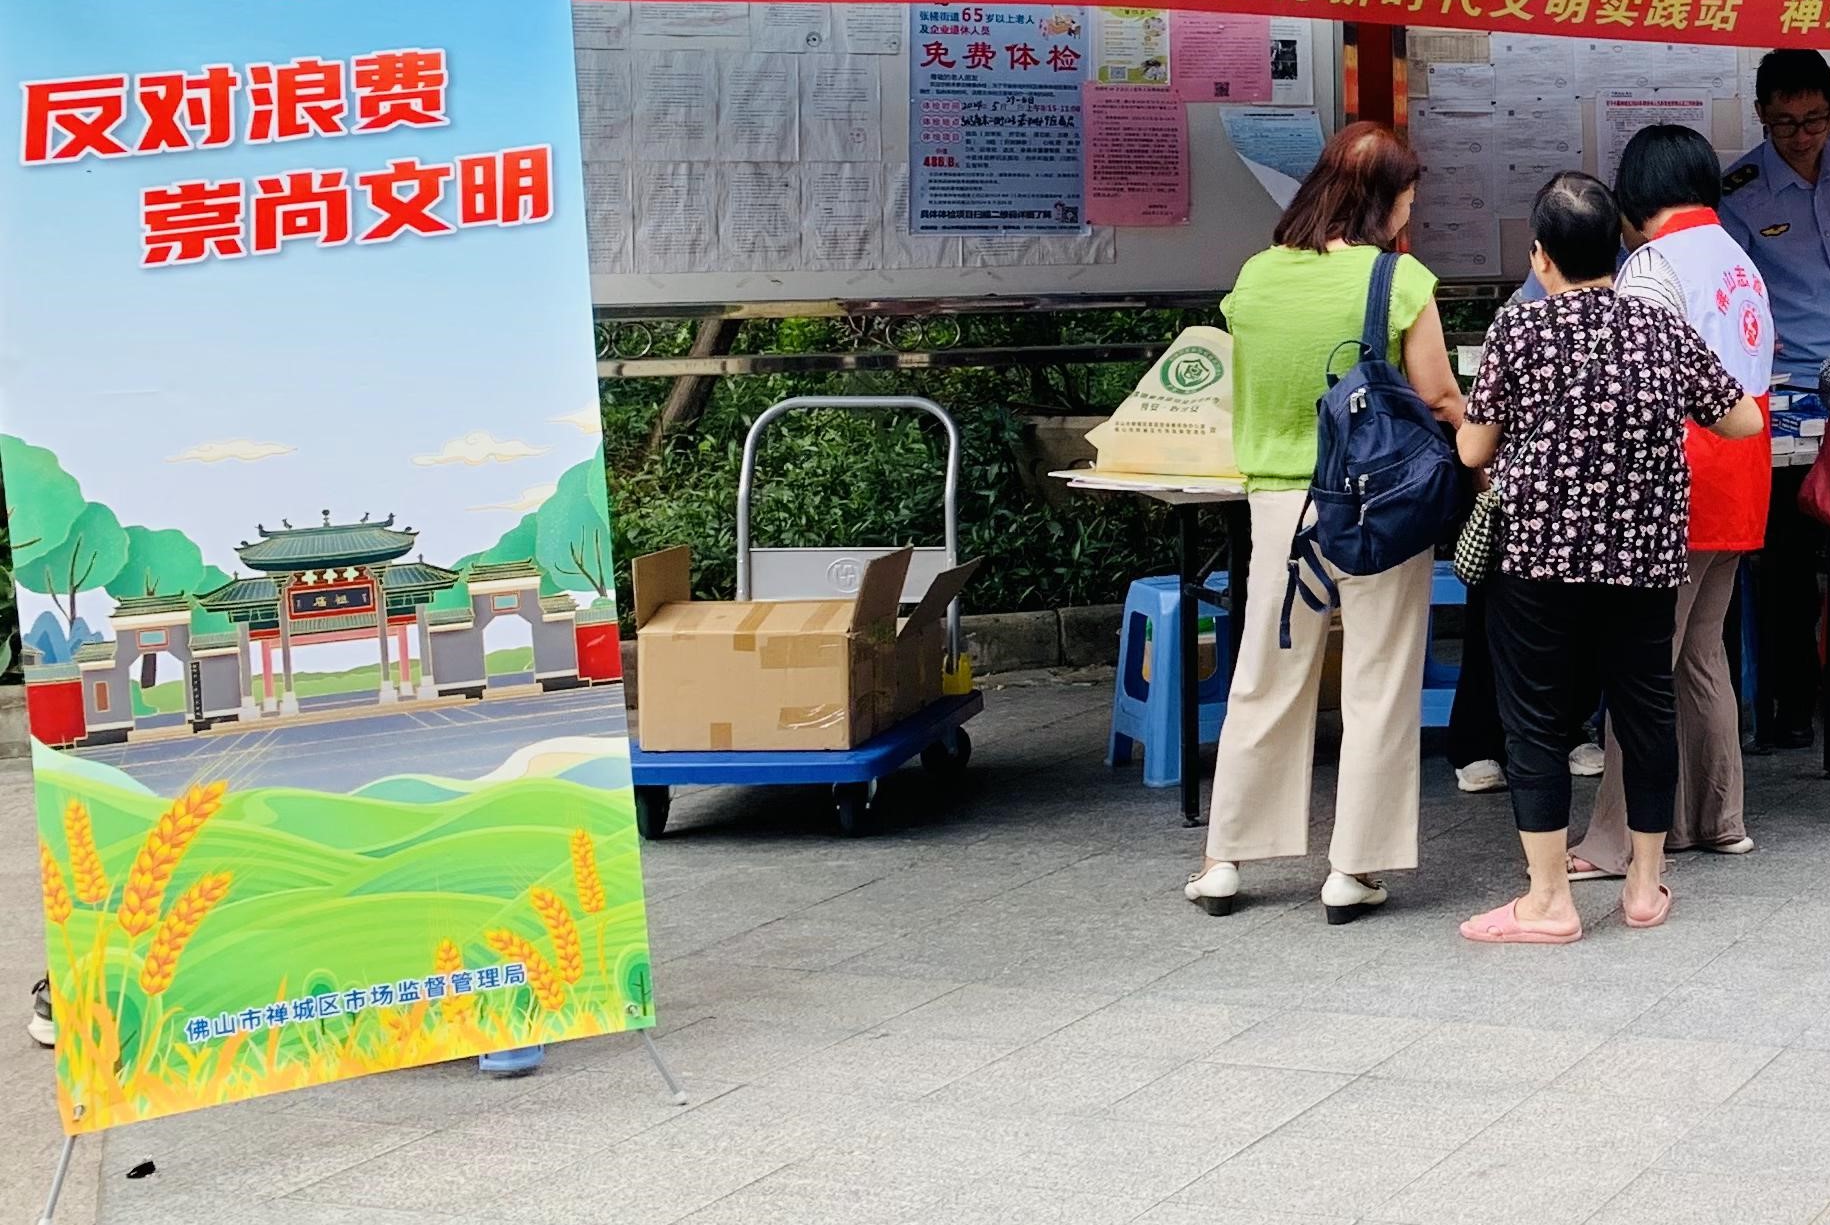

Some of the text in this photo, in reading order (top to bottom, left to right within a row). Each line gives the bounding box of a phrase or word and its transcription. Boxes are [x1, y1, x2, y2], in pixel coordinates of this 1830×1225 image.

[920, 40, 1082, 72] 免费体检
[22, 48, 448, 163] 反对浪费
[138, 145, 552, 266] 崇尚文明
[185, 963, 527, 1042] 佛山市禅城区市场监督管理局
